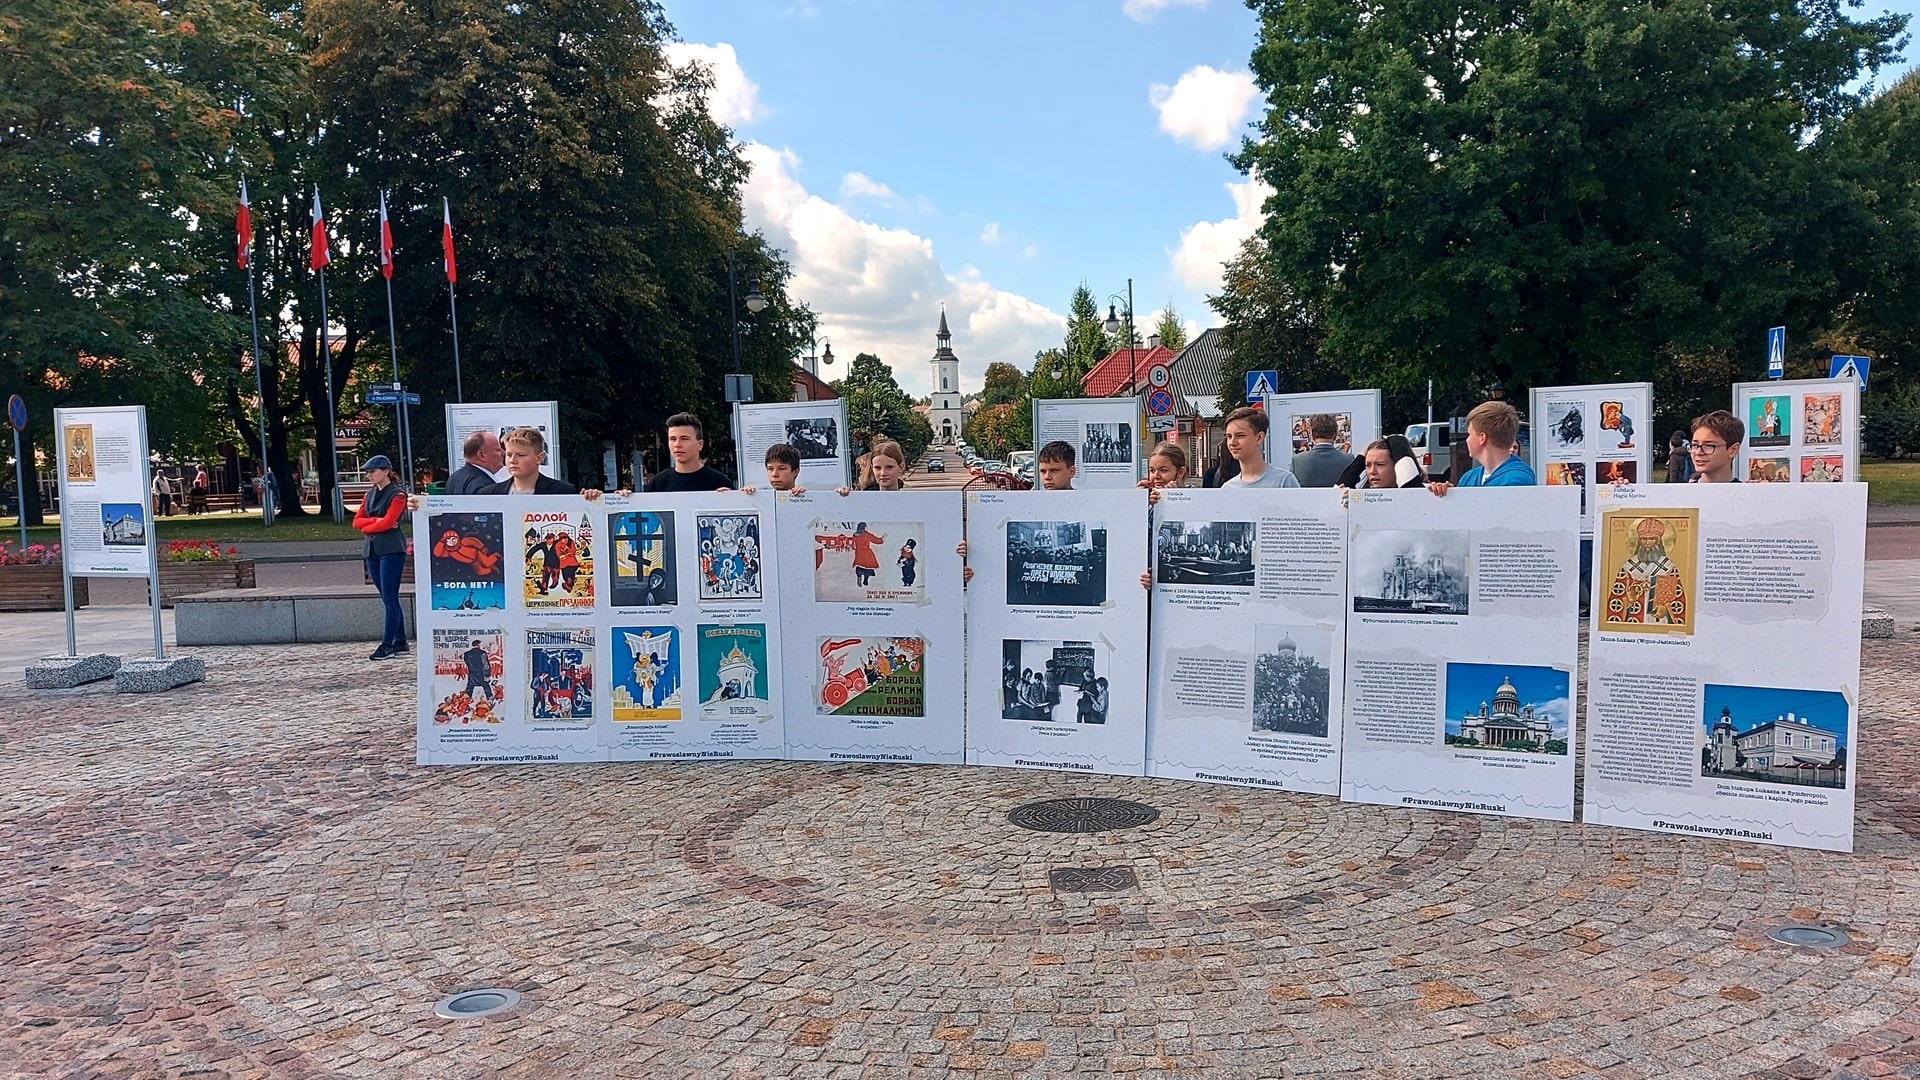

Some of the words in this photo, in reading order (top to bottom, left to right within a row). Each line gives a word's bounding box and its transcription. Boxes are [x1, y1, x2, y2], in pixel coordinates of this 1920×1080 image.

[525, 512, 567, 522] ДОЛОЙ
[1402, 797, 1506, 812] #PrawoslawnyNieRuski
[1653, 820, 1773, 840] #PrawoslawnyNieRuski
